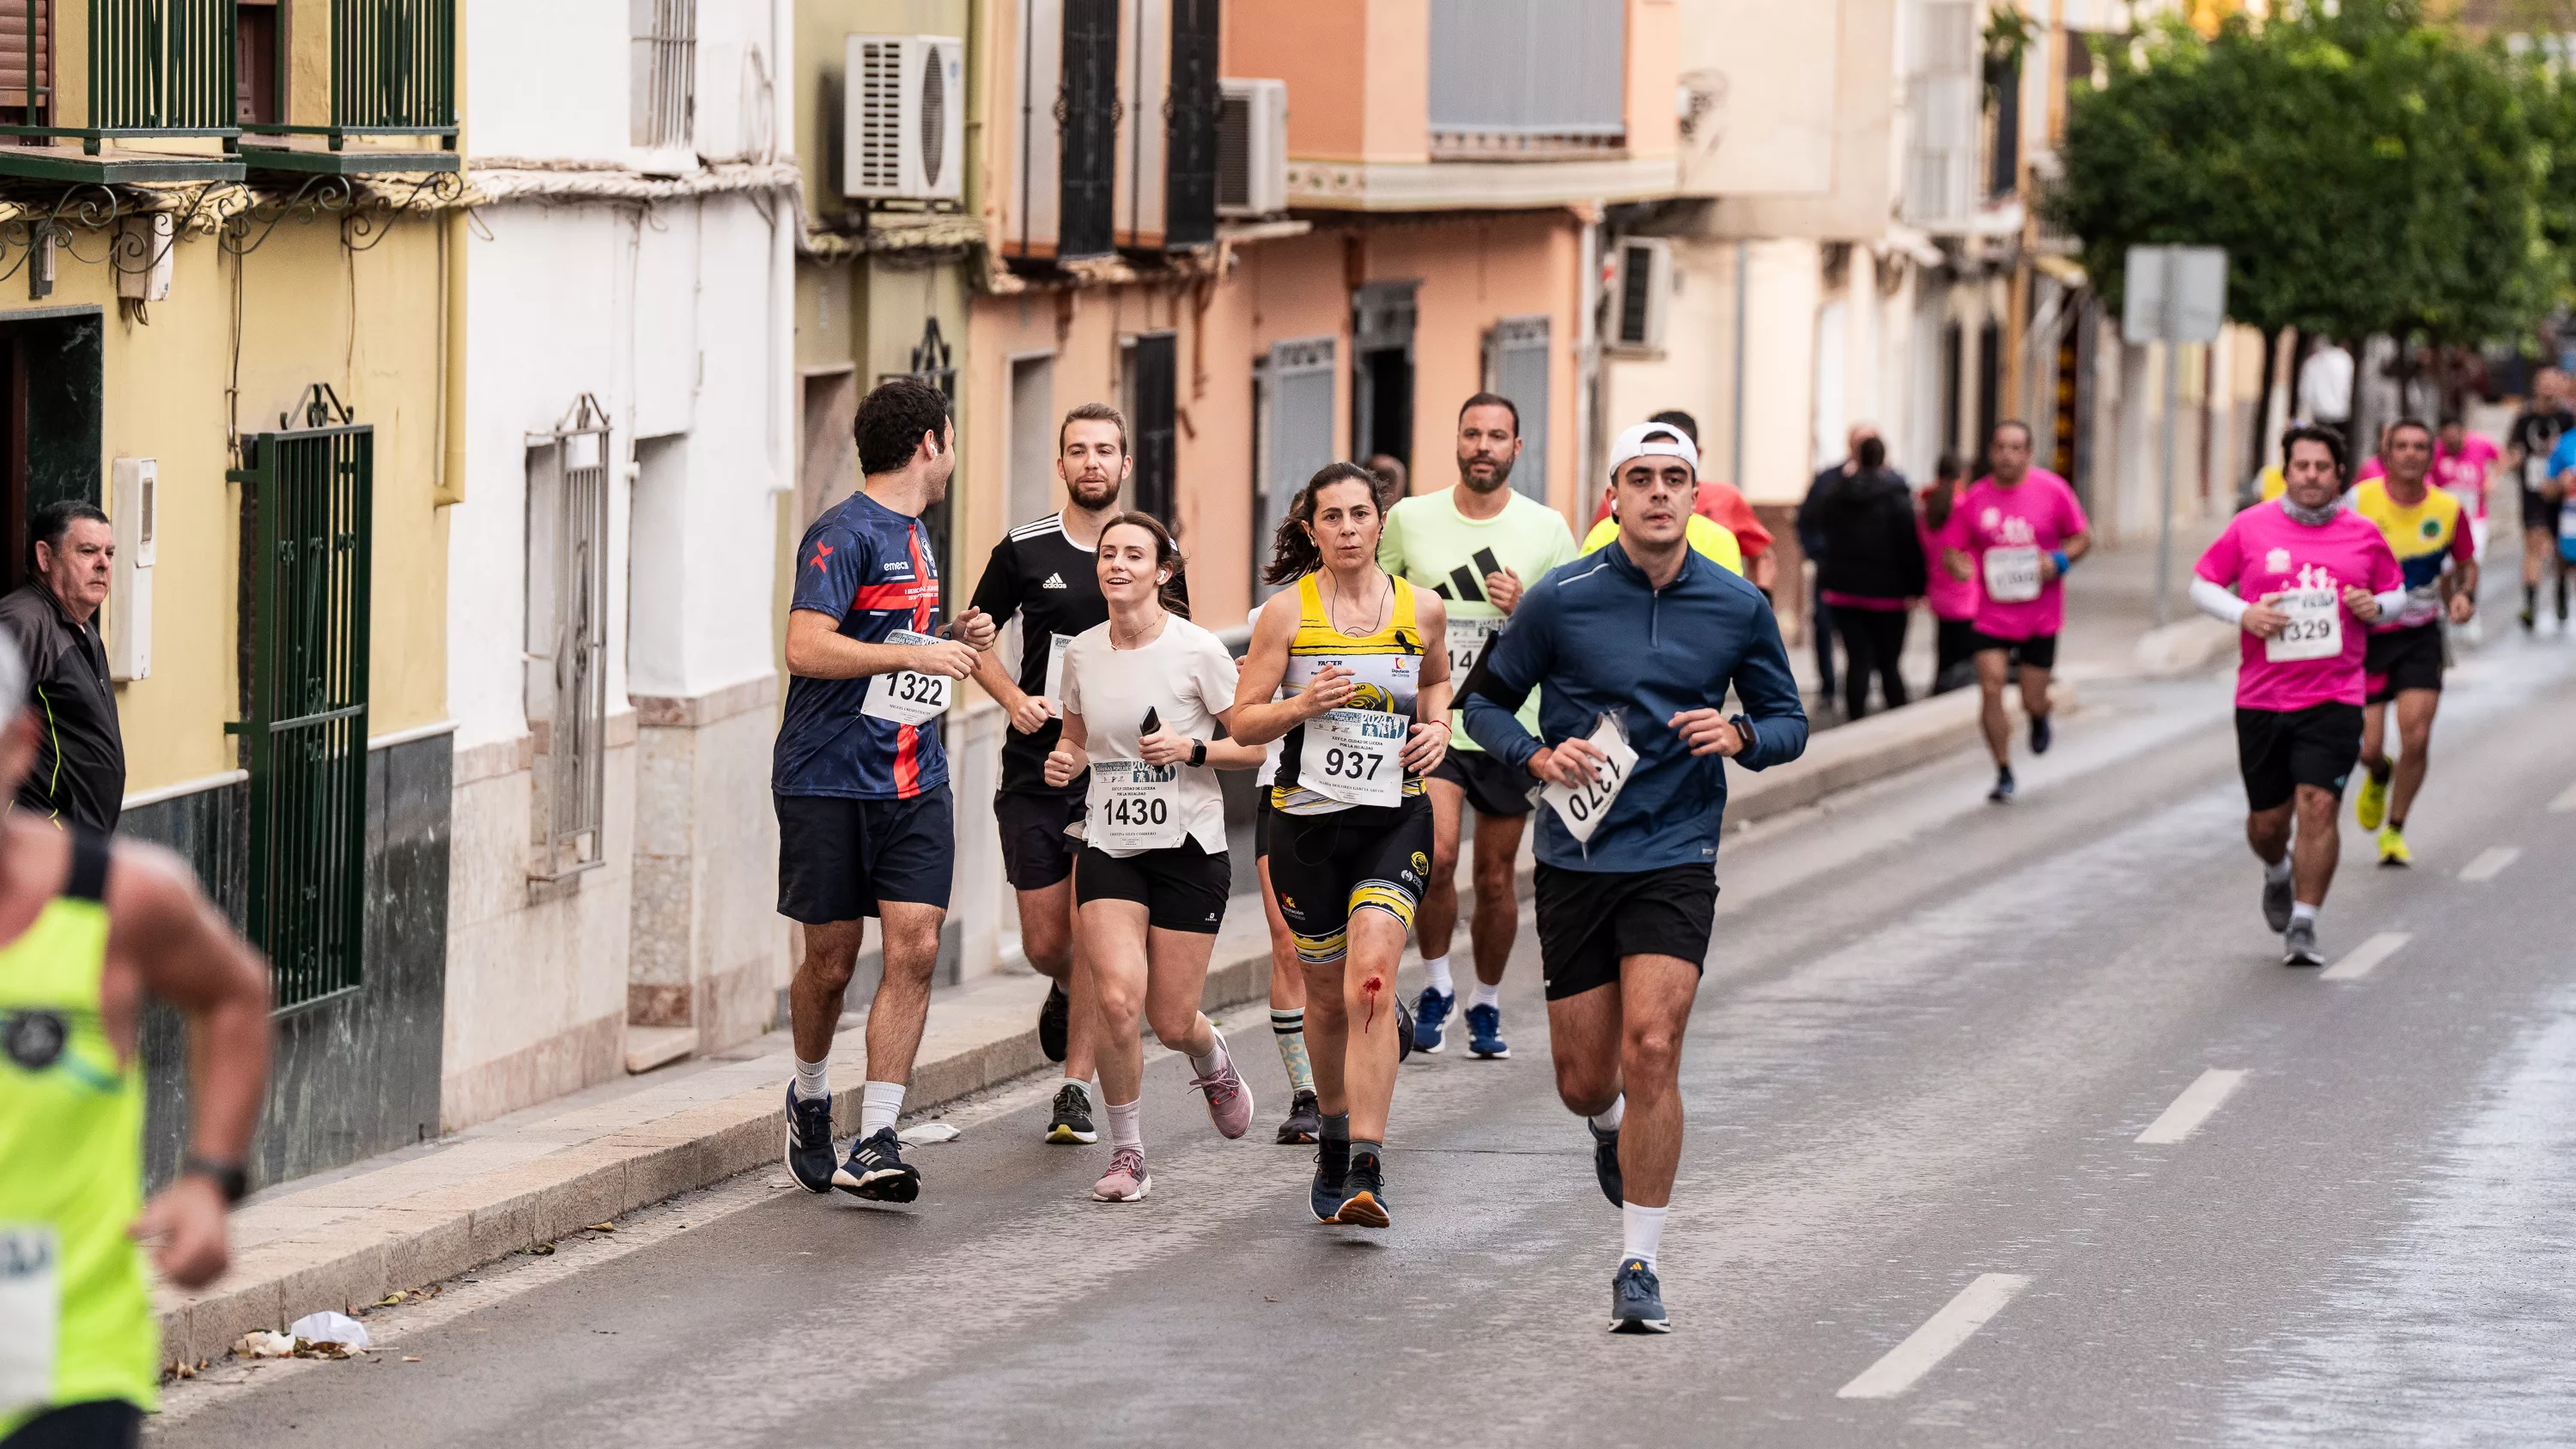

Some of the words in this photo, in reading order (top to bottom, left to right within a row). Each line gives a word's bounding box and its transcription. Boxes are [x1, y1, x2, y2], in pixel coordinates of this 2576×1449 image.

[886, 673, 942, 706] 1322
[1362, 713, 1387, 725] 2024
[1325, 749, 1383, 780] 937
[1104, 798, 1167, 825] 1430
